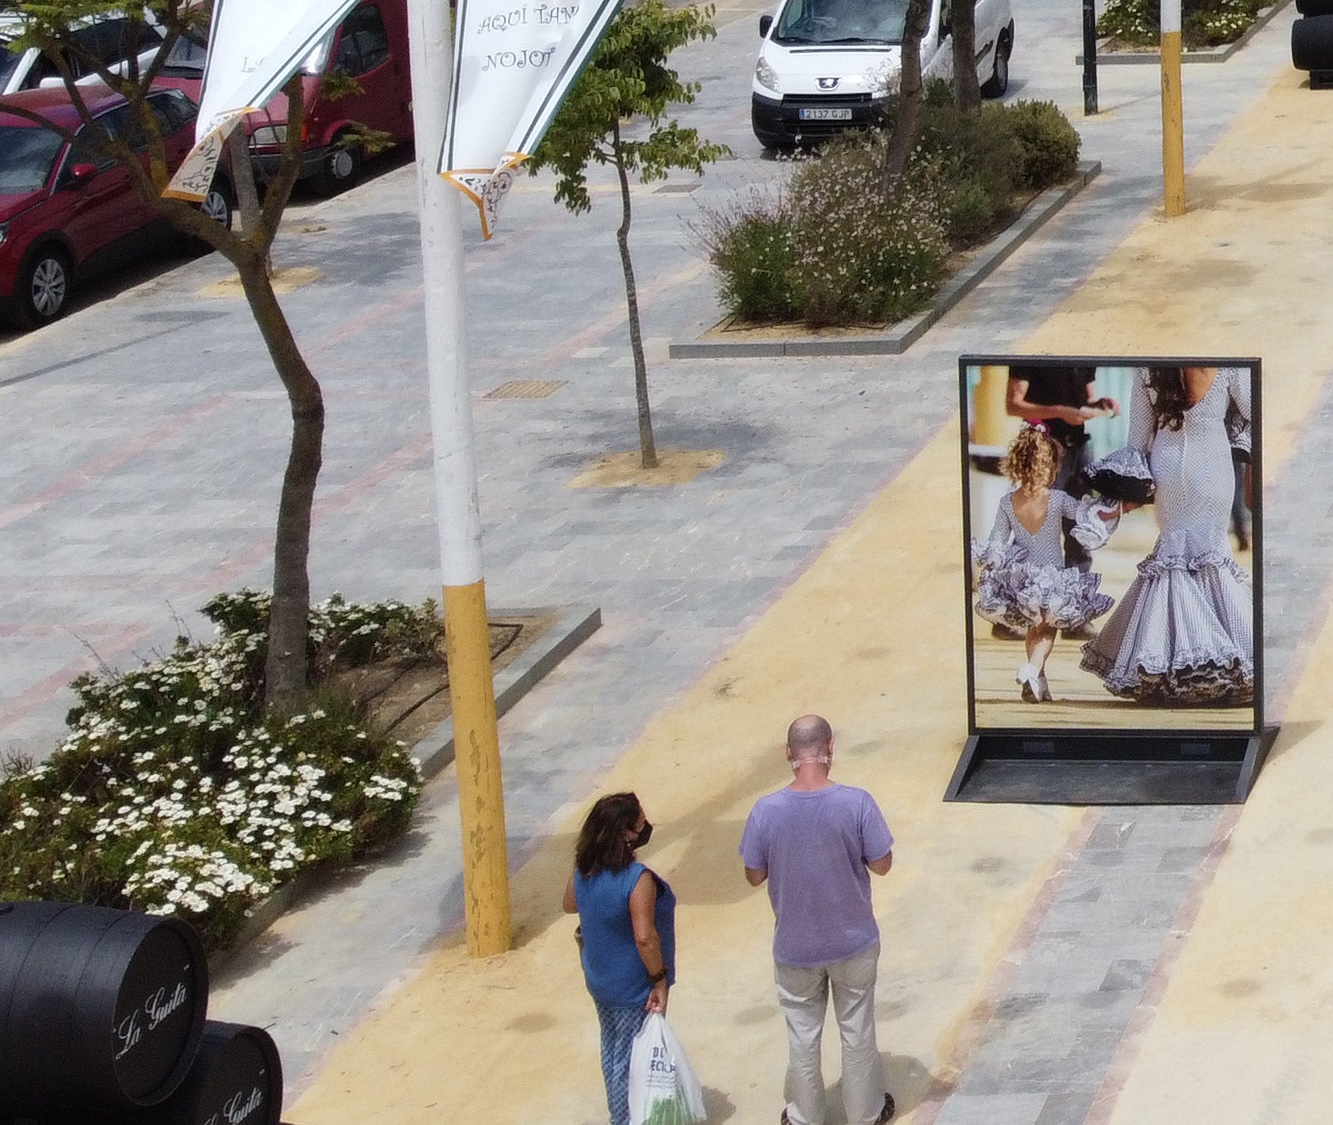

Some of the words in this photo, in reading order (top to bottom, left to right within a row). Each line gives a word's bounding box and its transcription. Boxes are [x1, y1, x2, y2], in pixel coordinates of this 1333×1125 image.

[477, 4, 528, 34] AQUÍ
[805, 109, 829, 119] 2137
[831, 109, 850, 119] GJP
[115, 1009, 142, 1060] La
[145, 982, 188, 1031] Guita
